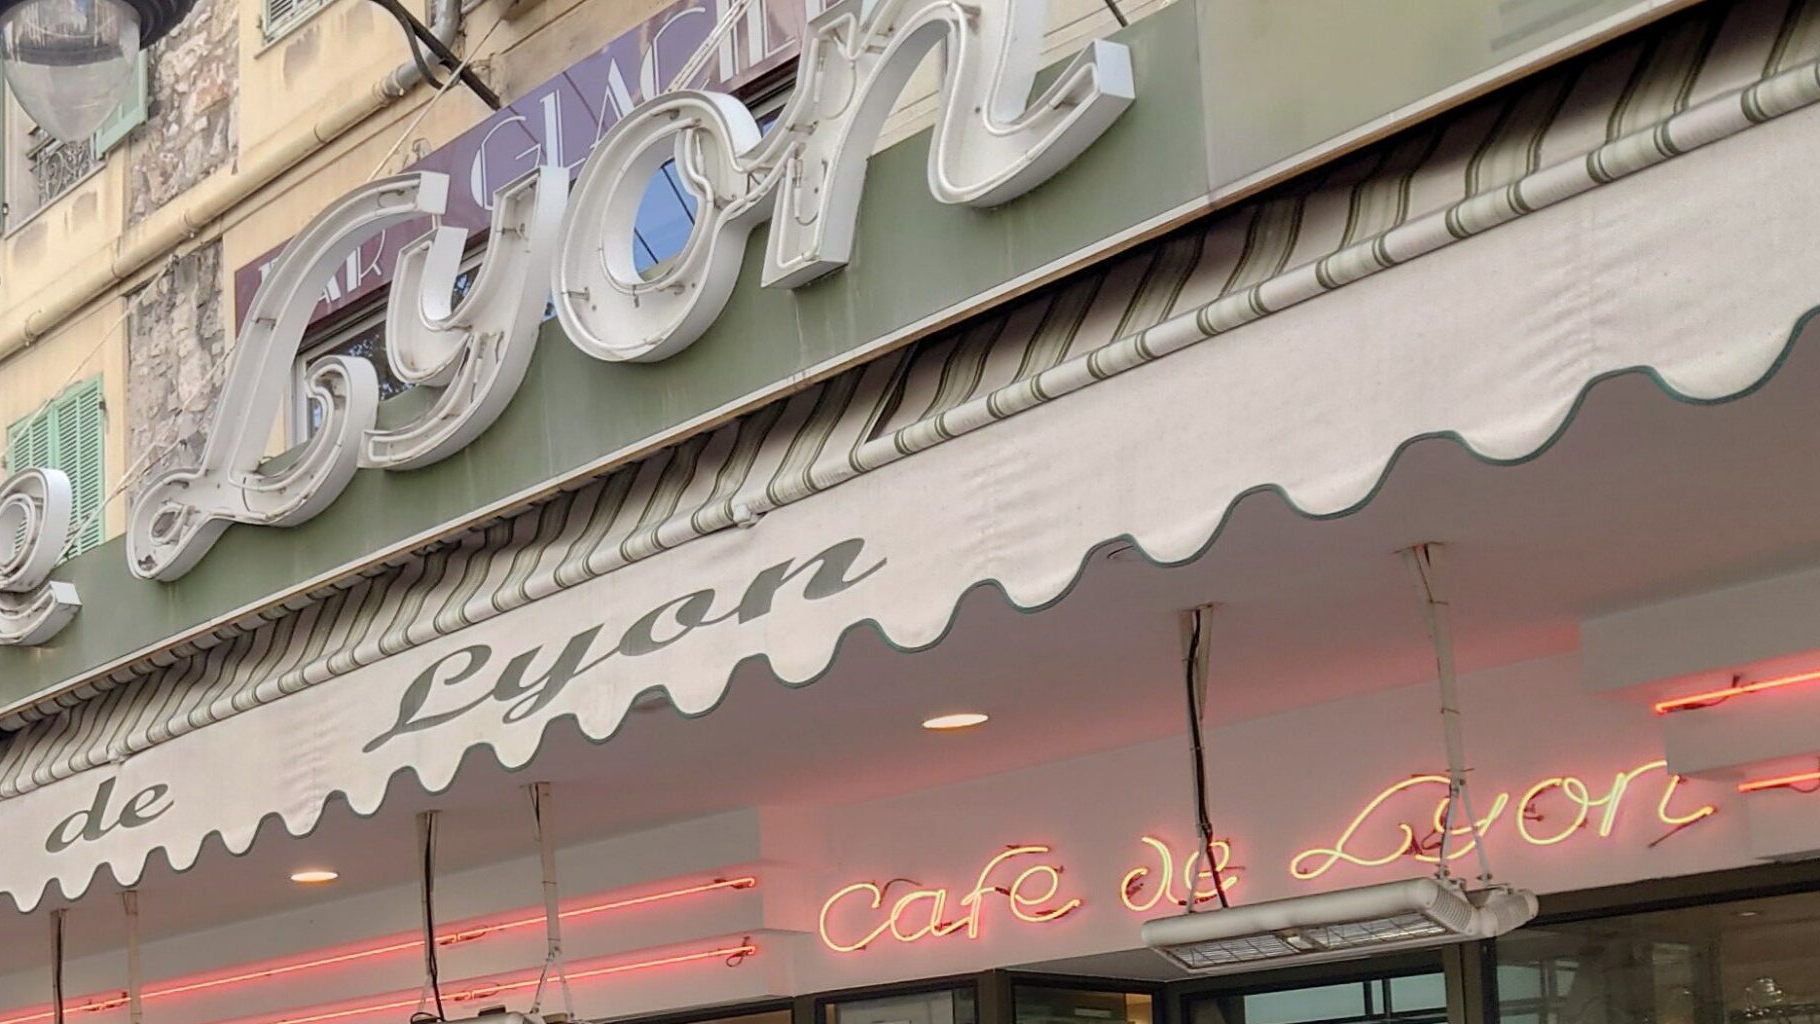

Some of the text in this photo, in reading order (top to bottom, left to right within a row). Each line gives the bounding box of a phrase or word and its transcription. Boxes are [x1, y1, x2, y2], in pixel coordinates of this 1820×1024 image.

[126, 0, 1136, 582] Lyon
[45, 776, 175, 854] de
[361, 537, 888, 754] Lyon
[1290, 761, 1716, 880] Lyon
